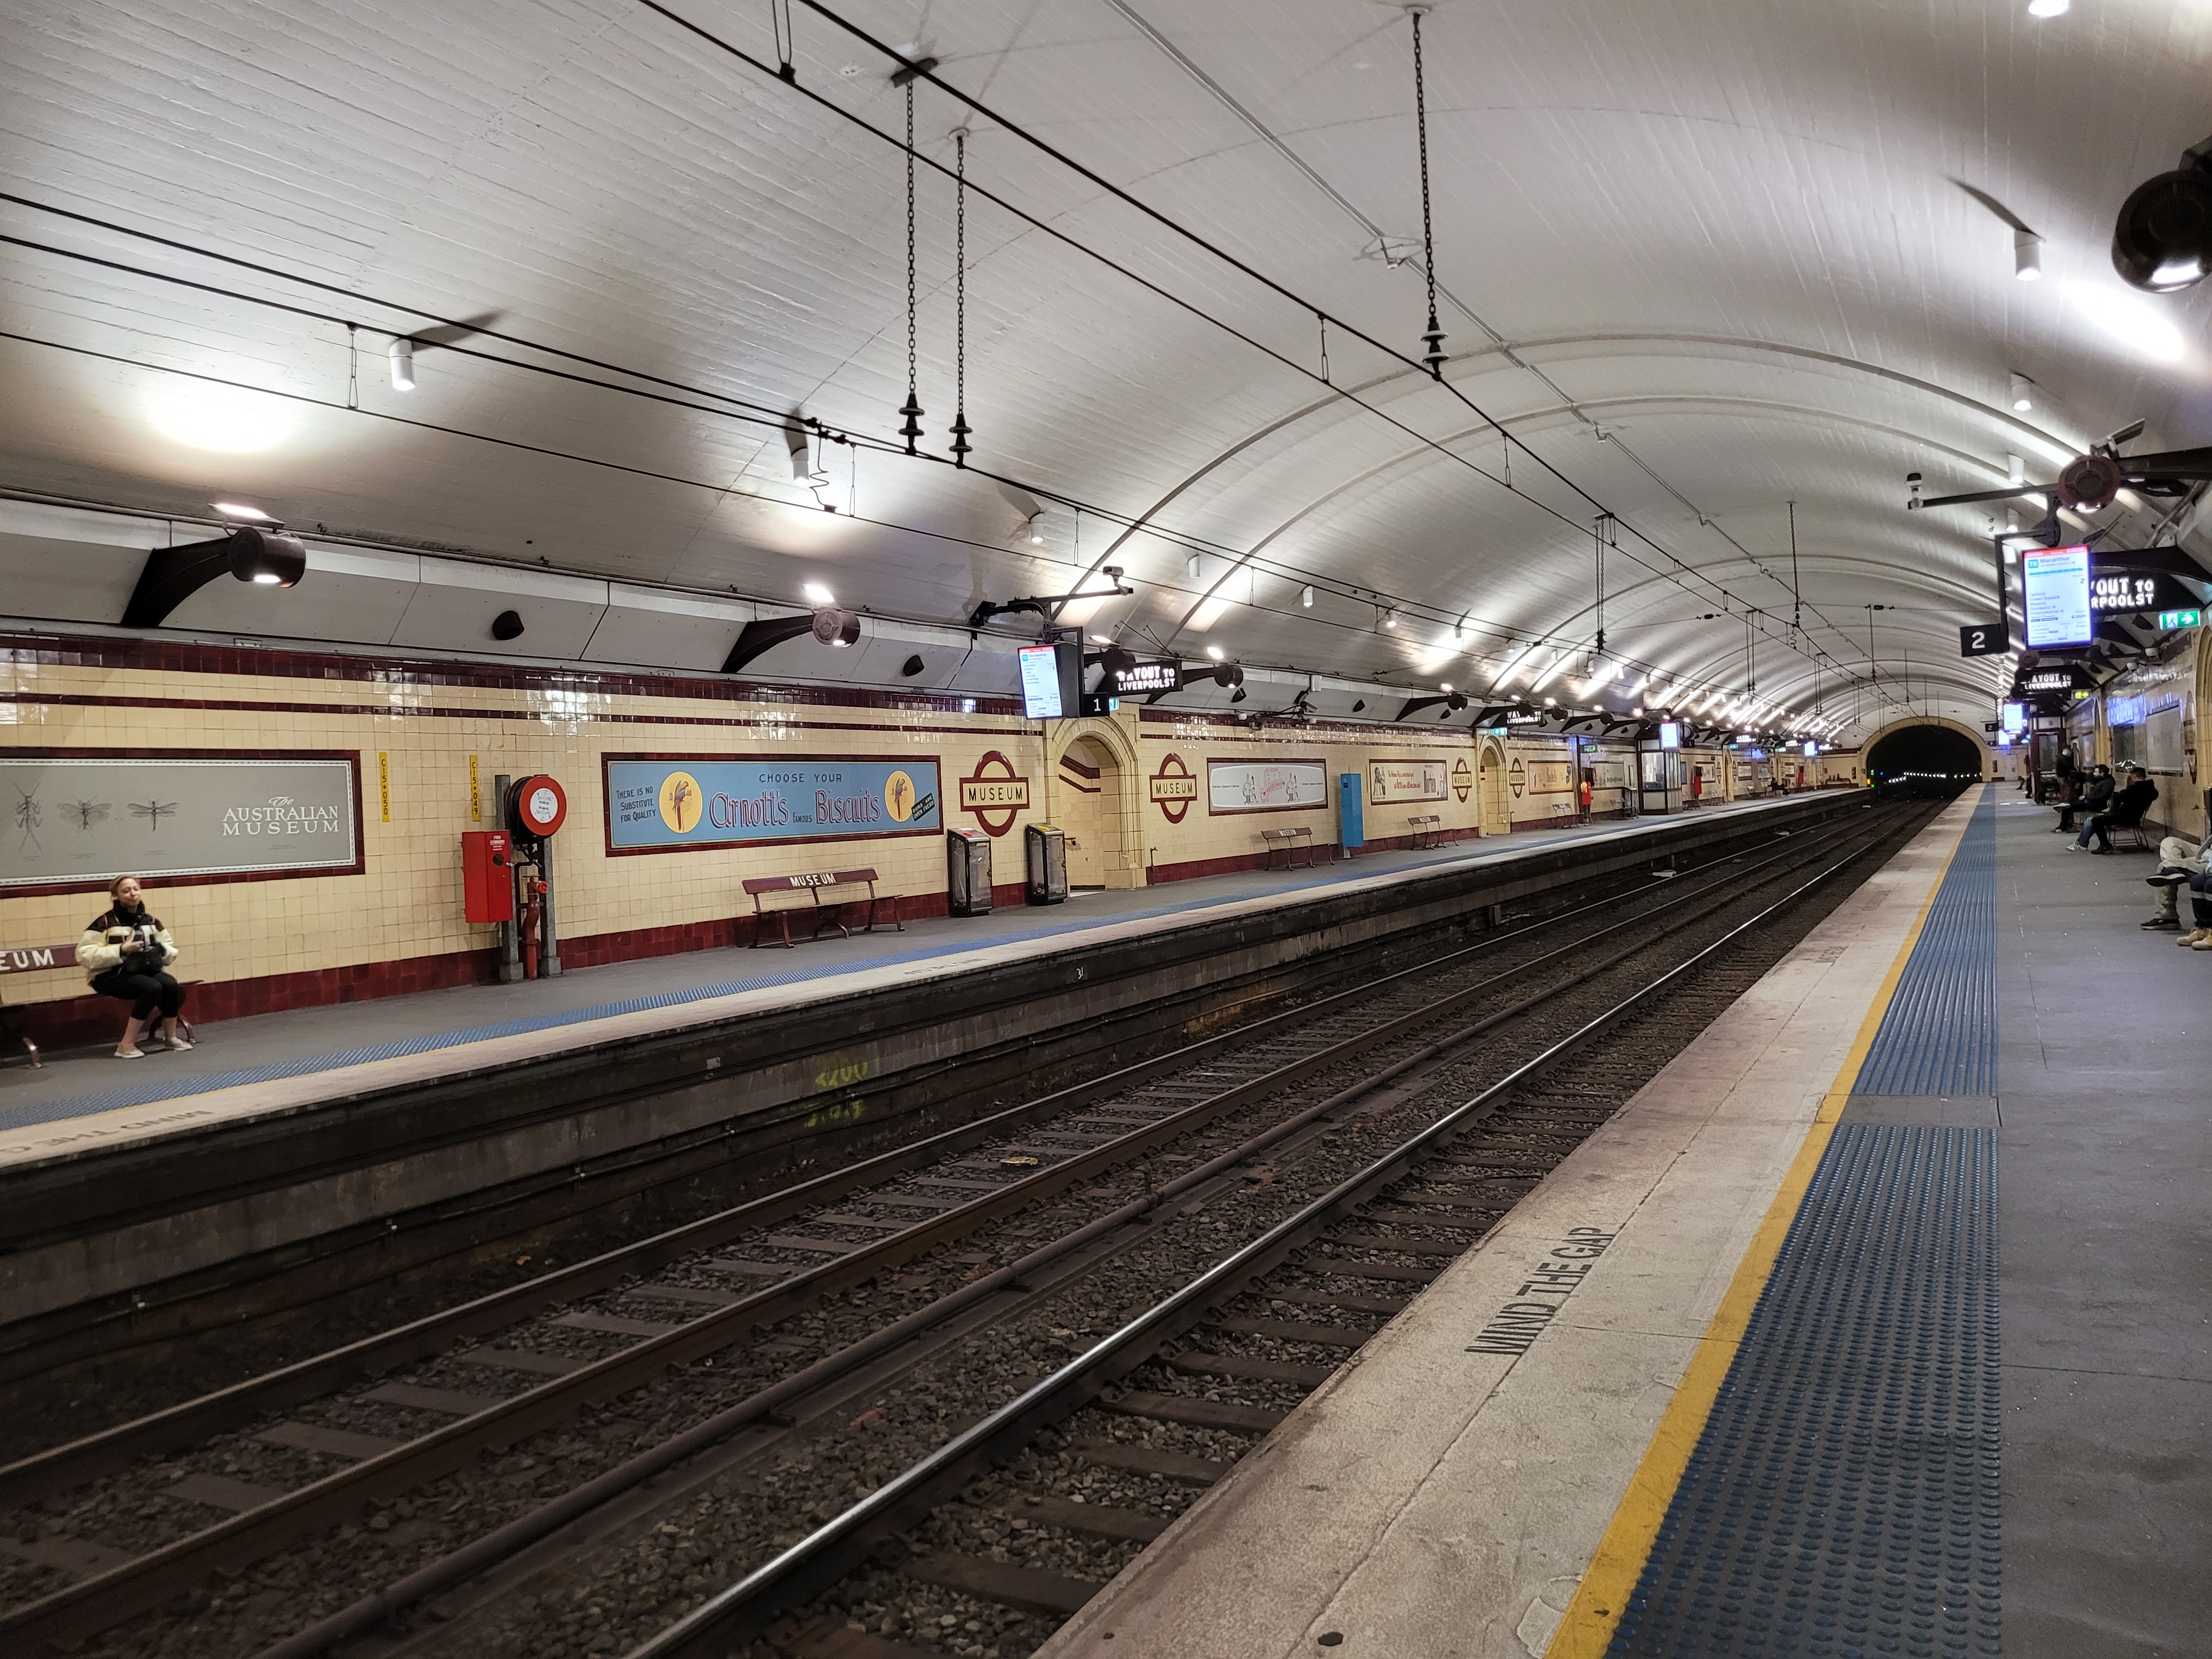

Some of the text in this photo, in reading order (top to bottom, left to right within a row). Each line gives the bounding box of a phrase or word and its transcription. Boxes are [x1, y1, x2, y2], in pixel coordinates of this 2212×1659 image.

[2135, 578, 2154, 592] TO
[1971, 631, 1985, 649] 2
[1163, 668, 1175, 678] TO
[1093, 698, 1101, 712] 1
[759, 773, 842, 783] CHOOSE YOUR
[616, 789, 635, 799] THERE
[645, 786, 653, 794] NO
[968, 787, 1023, 802] MUSEUM
[1155, 782, 1193, 794] MUSEUM
[269, 796, 294, 806] The
[620, 798, 654, 811] SUBSTITUTE
[815, 788, 881, 825] Biscuits
[912, 802, 923, 813] OURS
[223, 806, 338, 821] AUSTRALIAN
[620, 809, 656, 823] FOR QUALITY
[913, 800, 934, 819] OVEN FRESH
[222, 820, 339, 836] MUSEUM
[789, 873, 837, 887] MUSEUM
[1076, 966, 1084, 980] 31
[1464, 1227, 1616, 1356] MIND THE GAP
